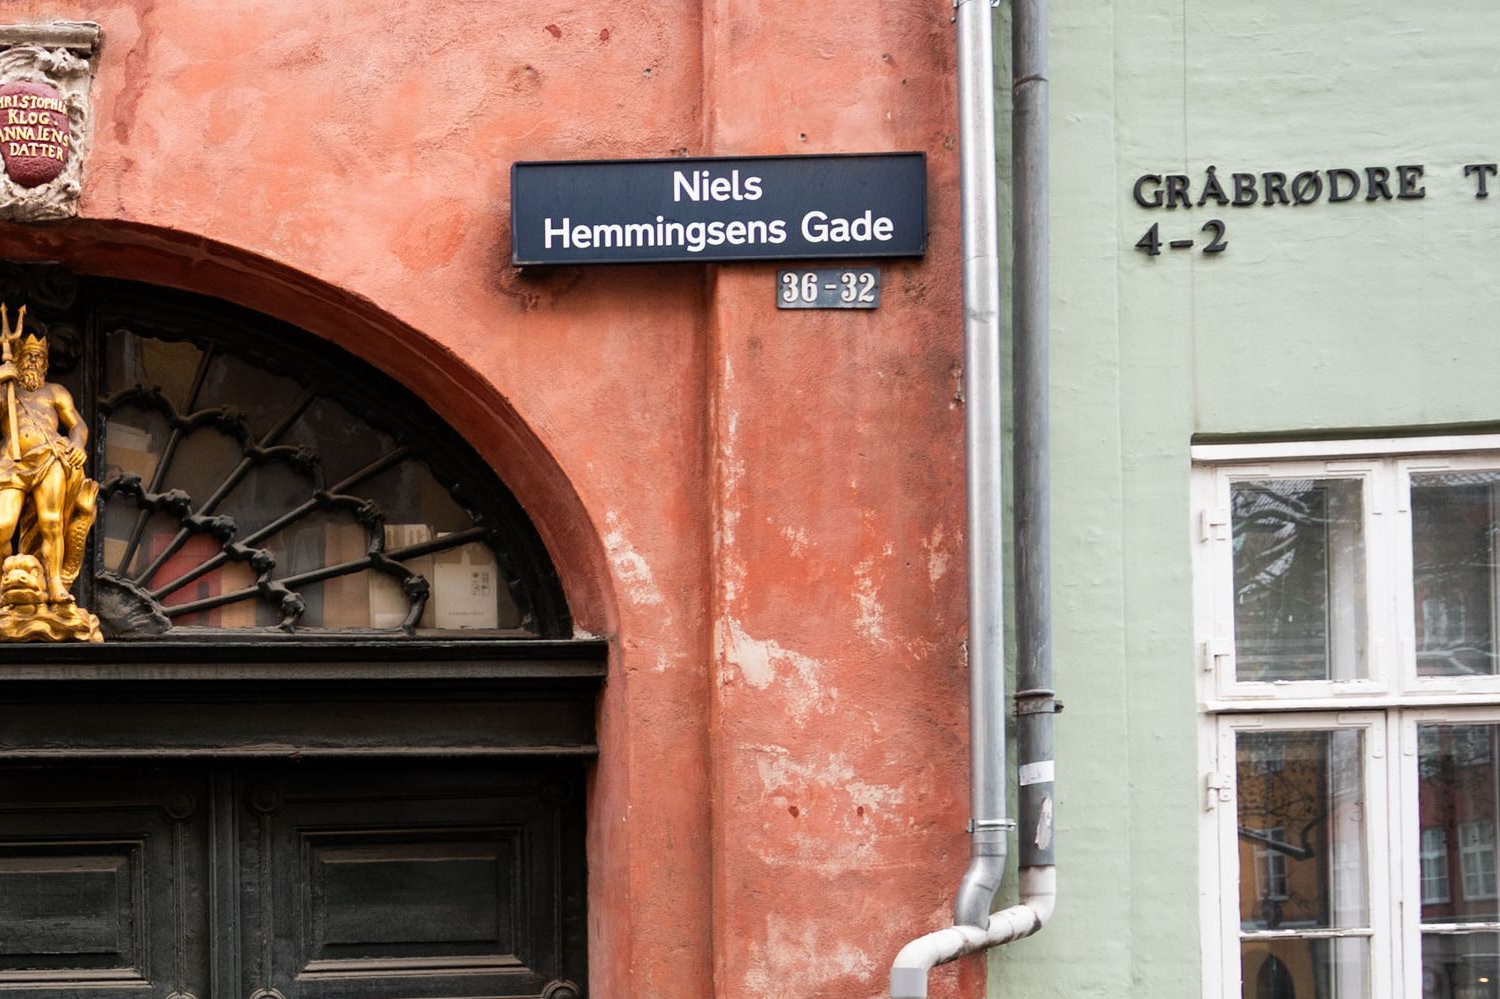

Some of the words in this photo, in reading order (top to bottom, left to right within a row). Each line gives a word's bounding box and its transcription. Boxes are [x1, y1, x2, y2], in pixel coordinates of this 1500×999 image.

[9, 142, 64, 161] DATTER
[673, 169, 763, 202] Niels
[1133, 165, 1426, 209] GRÅBRØDRE
[1464, 163, 1498, 198] T
[544, 215, 787, 252] Hemmingsens
[801, 210, 894, 243] Gade
